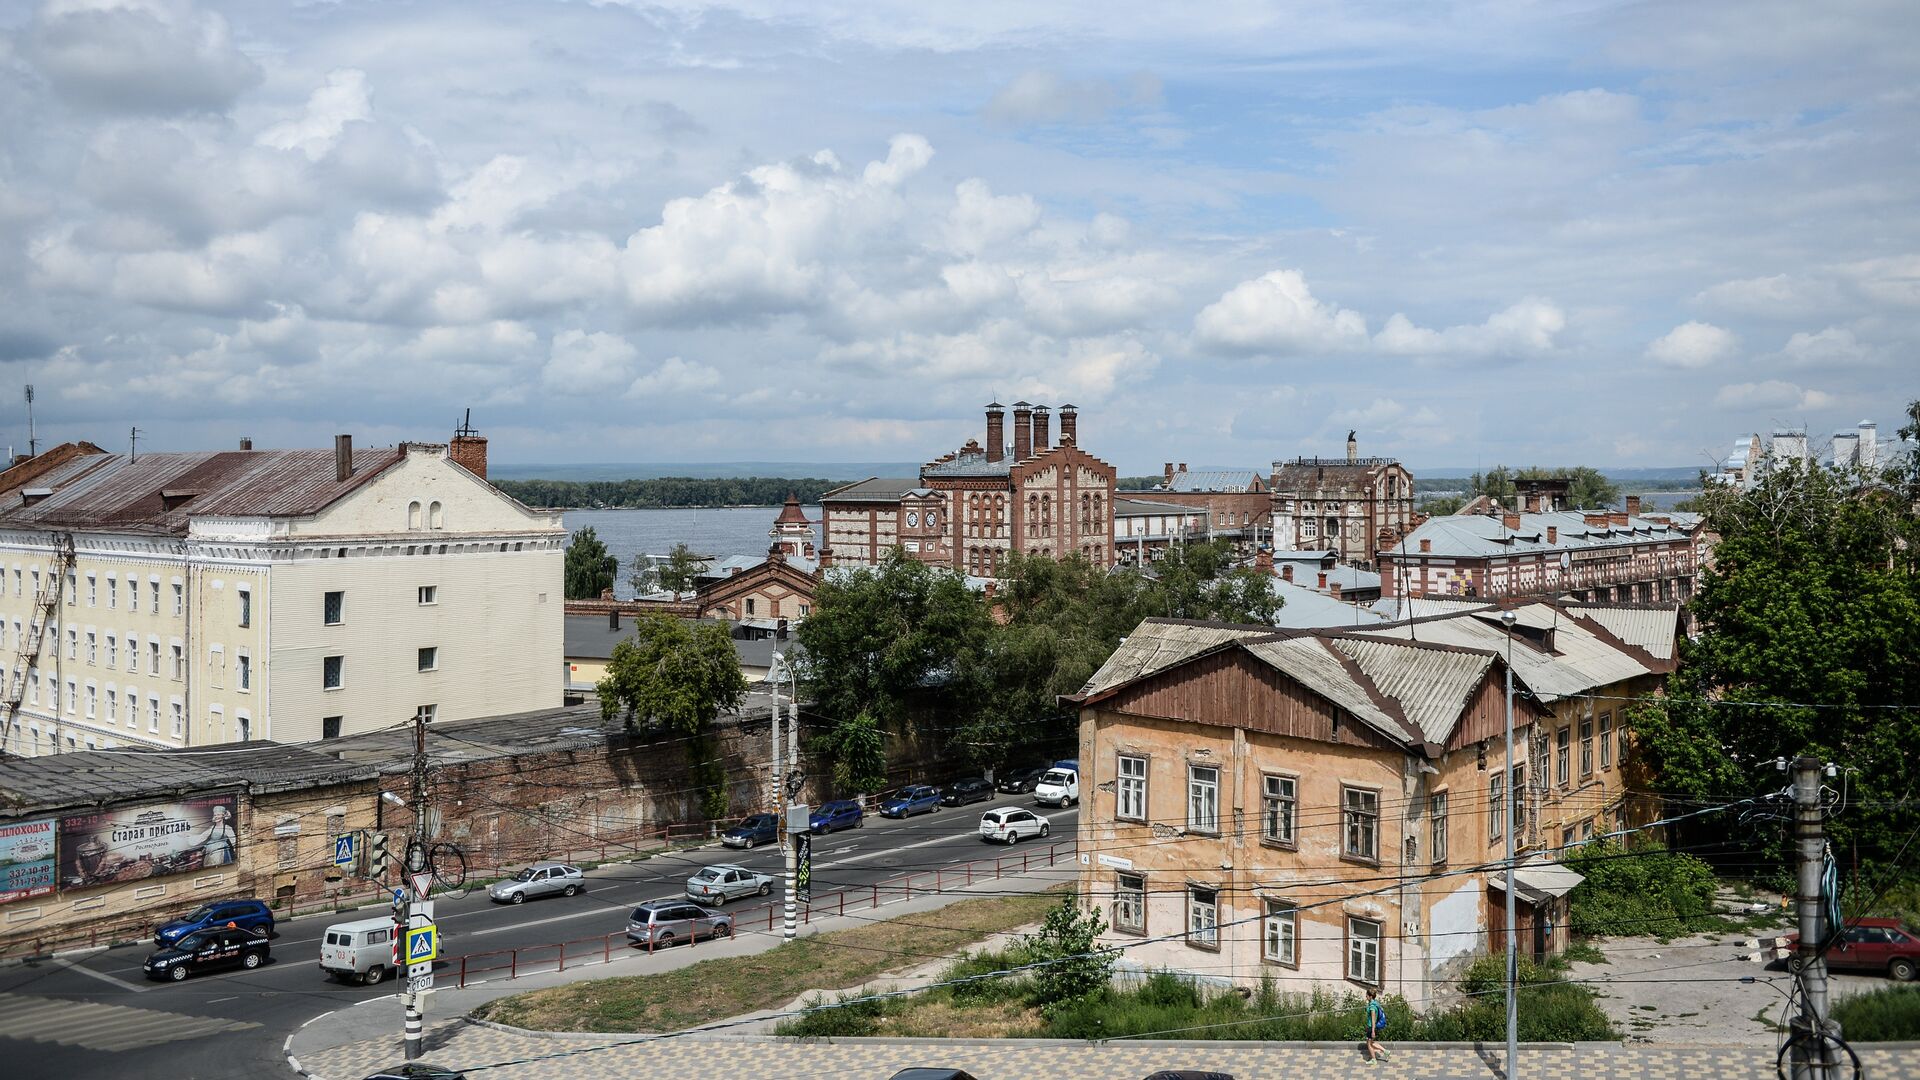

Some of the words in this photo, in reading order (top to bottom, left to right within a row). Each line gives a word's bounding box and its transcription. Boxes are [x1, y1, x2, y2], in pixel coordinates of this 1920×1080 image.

[112, 829, 145, 842] Старая
[149, 822, 191, 838] пристань
[337, 951, 345, 960] 03
[412, 977, 431, 991] СТОП
